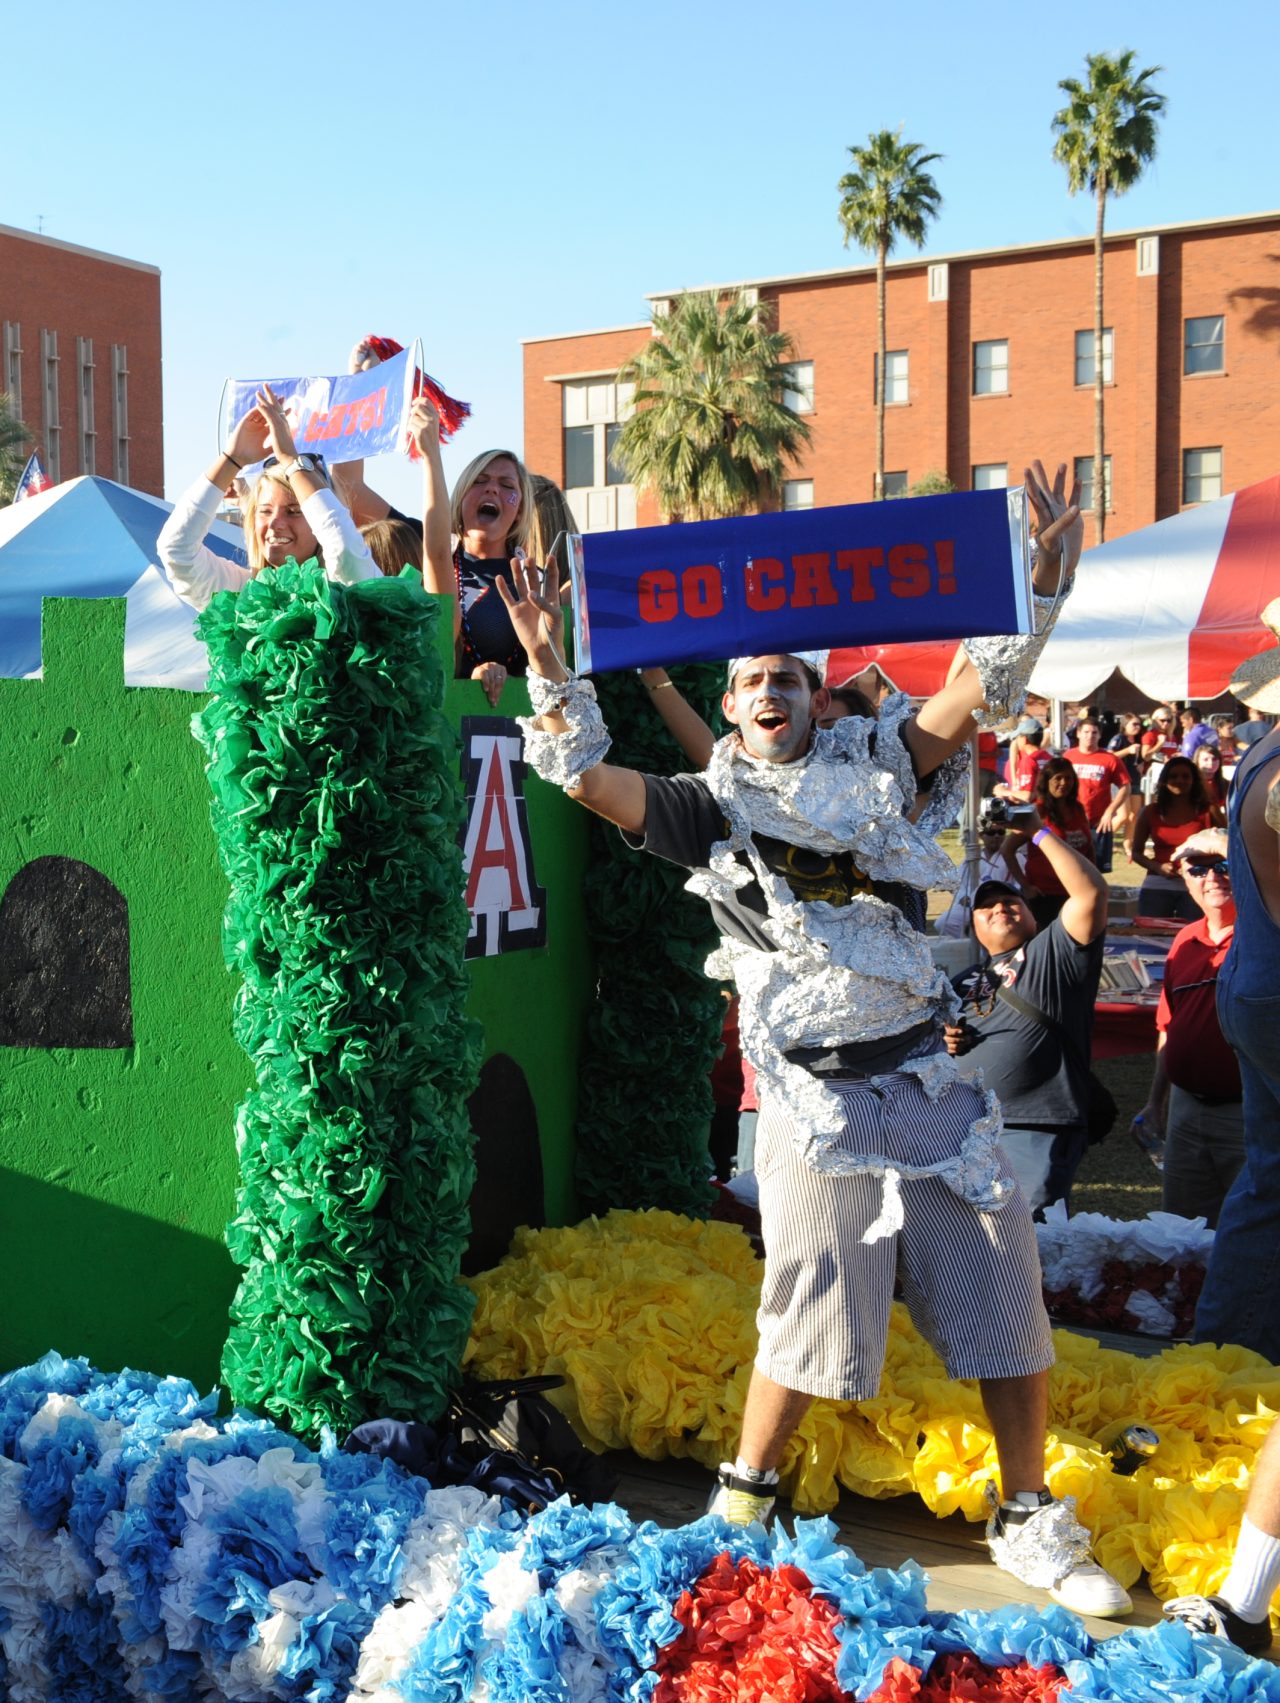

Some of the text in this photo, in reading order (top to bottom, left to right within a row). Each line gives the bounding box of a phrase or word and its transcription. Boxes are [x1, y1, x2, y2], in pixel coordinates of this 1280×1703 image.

[304, 386, 388, 443] CATS!
[637, 540, 958, 624] GO CATS!
[460, 728, 542, 958] A
